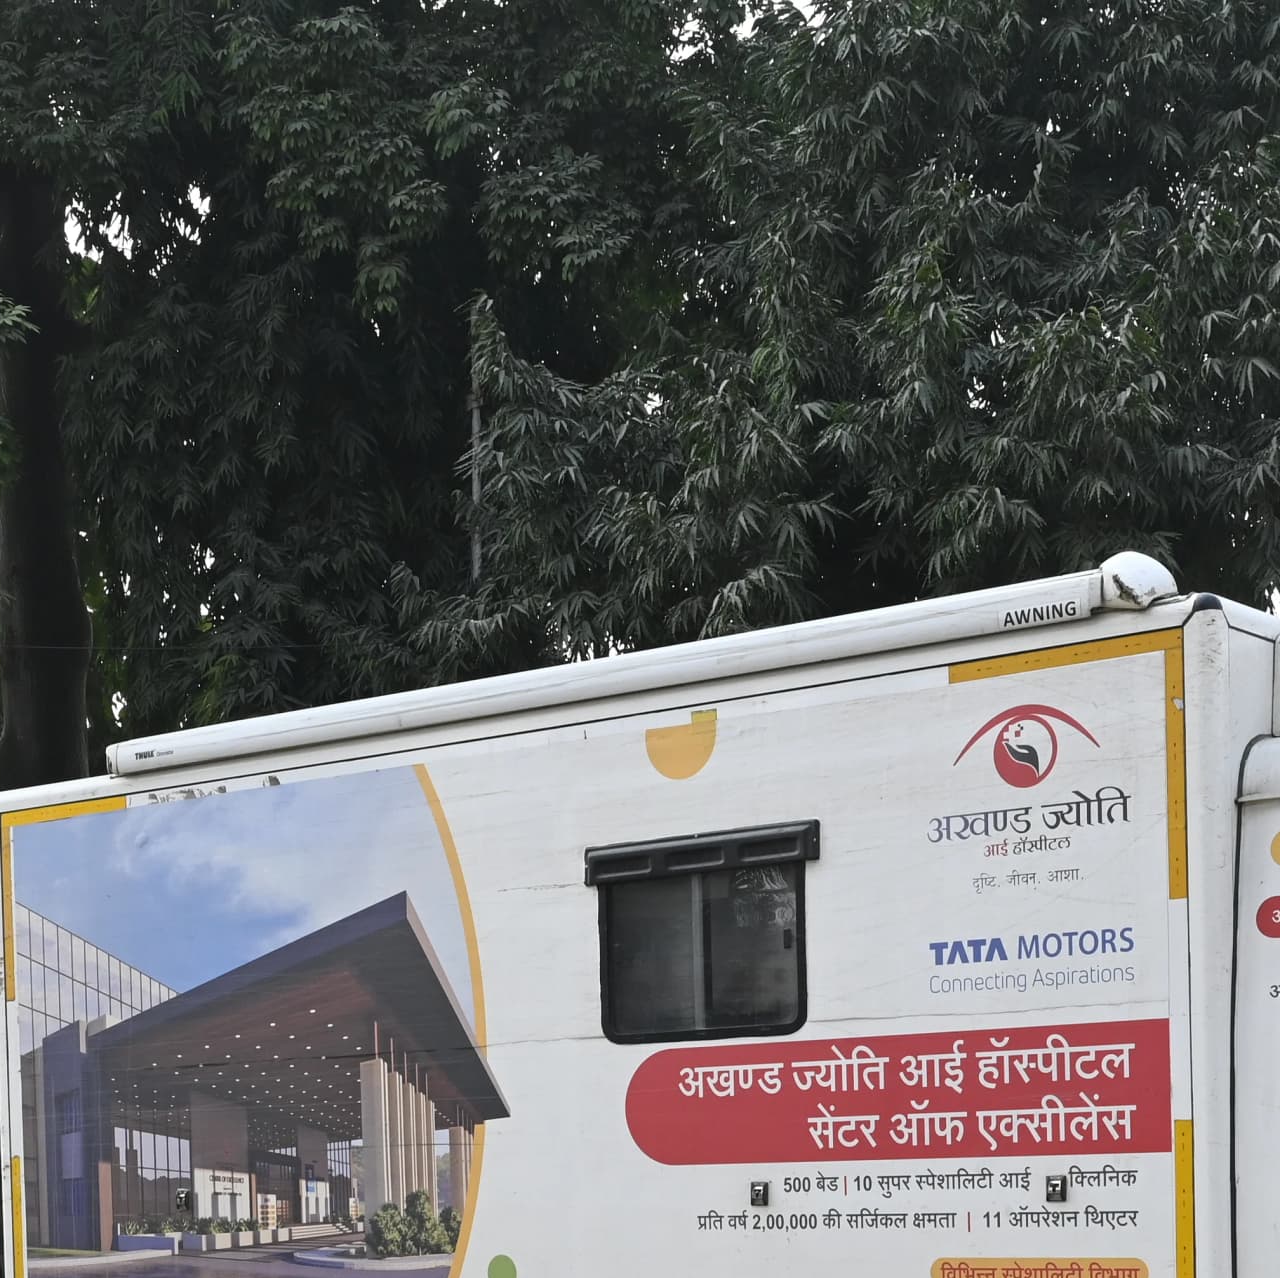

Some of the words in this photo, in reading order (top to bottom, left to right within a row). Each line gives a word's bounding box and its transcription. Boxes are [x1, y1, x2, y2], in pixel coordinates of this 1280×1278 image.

[1004, 601, 1077, 628] AWNING
[927, 806, 1032, 843] अखण्ड
[1041, 786, 1131, 830] ज्योति
[984, 839, 1008, 857] आई
[1013, 834, 1071, 856] हॉस्पीटल
[929, 937, 1008, 965] TATA
[1018, 927, 1135, 960] MOTORS
[929, 971, 1027, 994] Connecting
[1032, 964, 1135, 990] Aspirations
[679, 1062, 783, 1098] अखण्ड
[792, 1045, 889, 1093] ज्योति
[899, 1040, 967, 1094] आई
[976, 1034, 1135, 1088] हॉस्पीटल
[808, 1103, 879, 1150] सेंटर
[889, 1099, 967, 1147] ऑफ
[977, 1092, 1136, 1151] एक्सीलेंस
[783, 1177, 811, 1193] 500
[816, 1171, 839, 1192] बेड
[853, 1175, 871, 1191] 10
[877, 1175, 911, 1198] सुपर
[915, 1168, 994, 1190] स्पेशालिटी
[999, 1167, 1031, 1191] आई
[1068, 1165, 1138, 1188] क्लिनिक
[697, 1209, 724, 1230] प्रति
[728, 1210, 748, 1230] वर्ष
[752, 1213, 818, 1232] 2,00,000
[822, 1208, 842, 1230] की
[846, 1208, 908, 1230] सर्जिकल
[912, 1211, 957, 1229] क्षमता
[983, 1211, 1001, 1228] 11
[1009, 1205, 1080, 1229] ऑपरेशन
[1084, 1205, 1139, 1230] थिएटर
